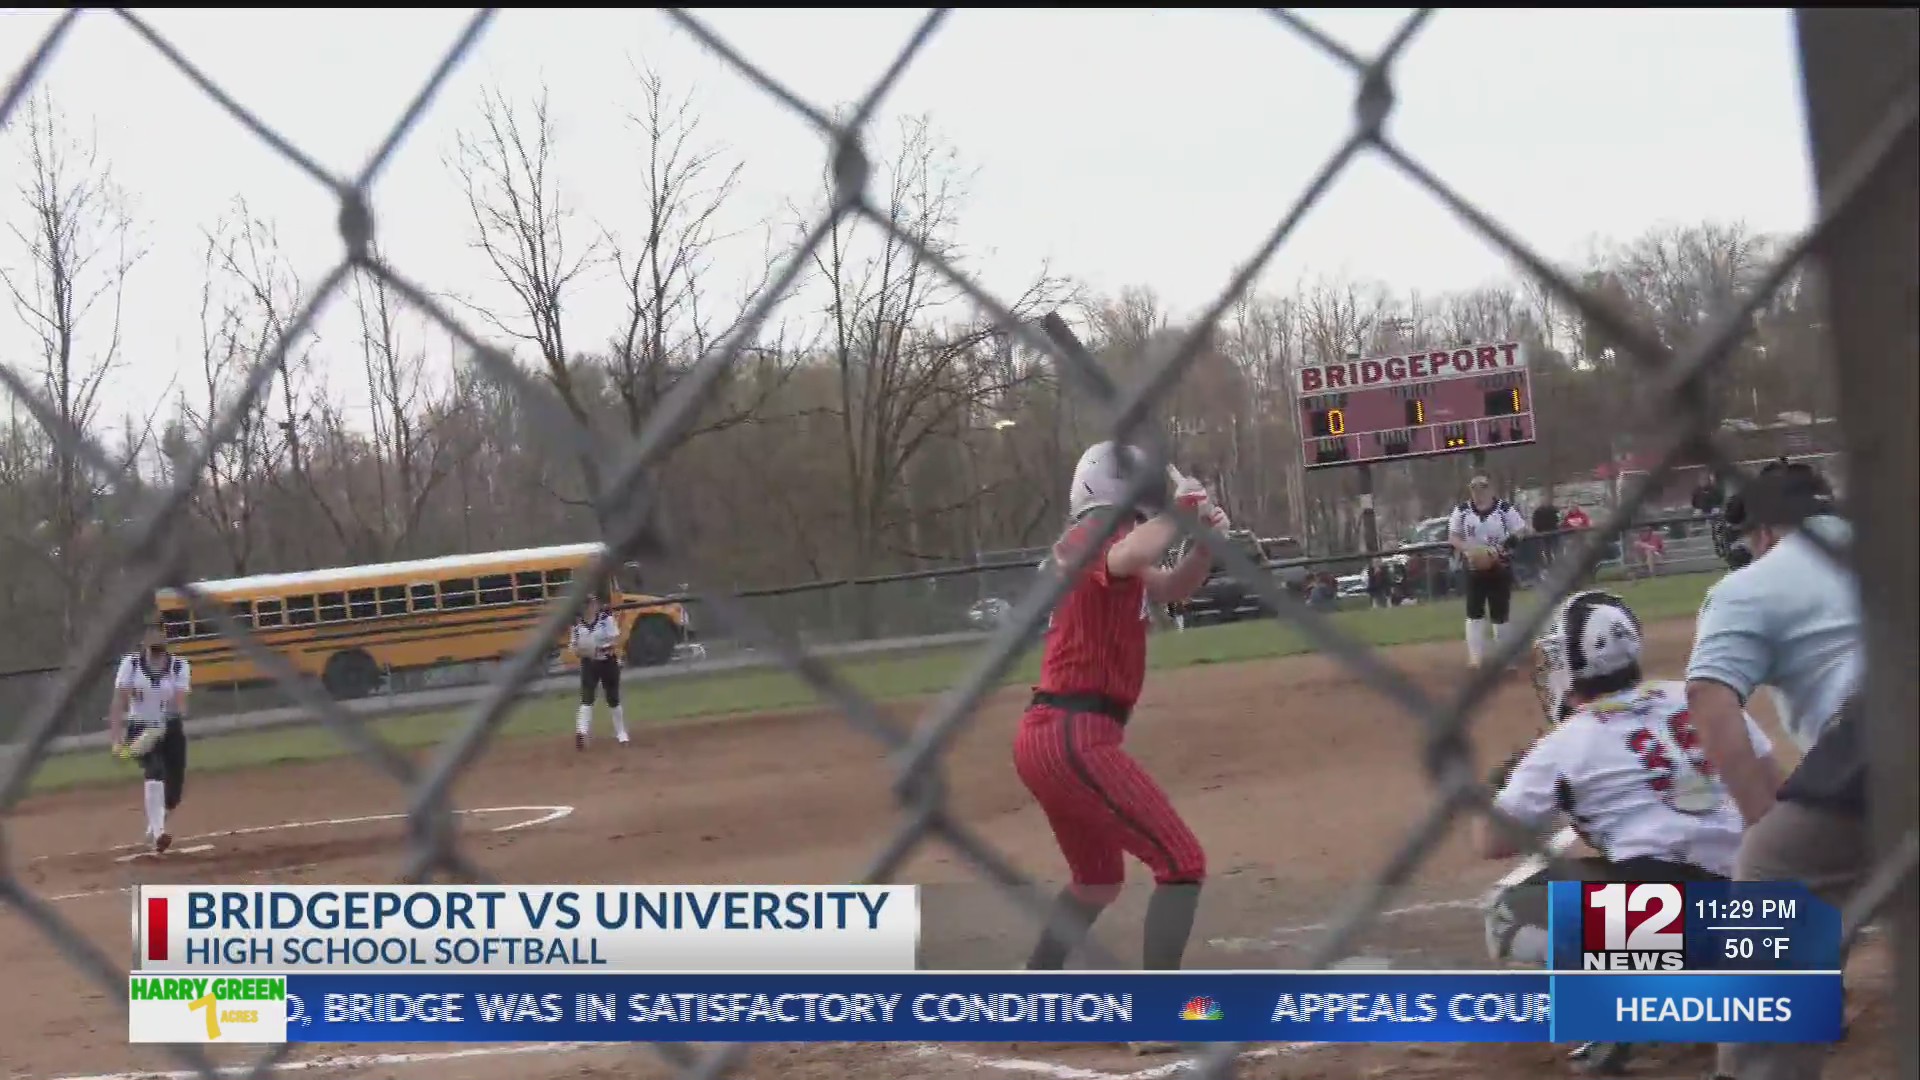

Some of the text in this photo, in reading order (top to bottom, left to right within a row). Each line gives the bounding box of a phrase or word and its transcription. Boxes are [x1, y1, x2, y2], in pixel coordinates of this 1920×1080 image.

[1301, 342, 1519, 391] BRIDGEPORT
[1415, 399, 1425, 424] 1
[1511, 387, 1521, 413] 1
[1328, 408, 1345, 435] 0
